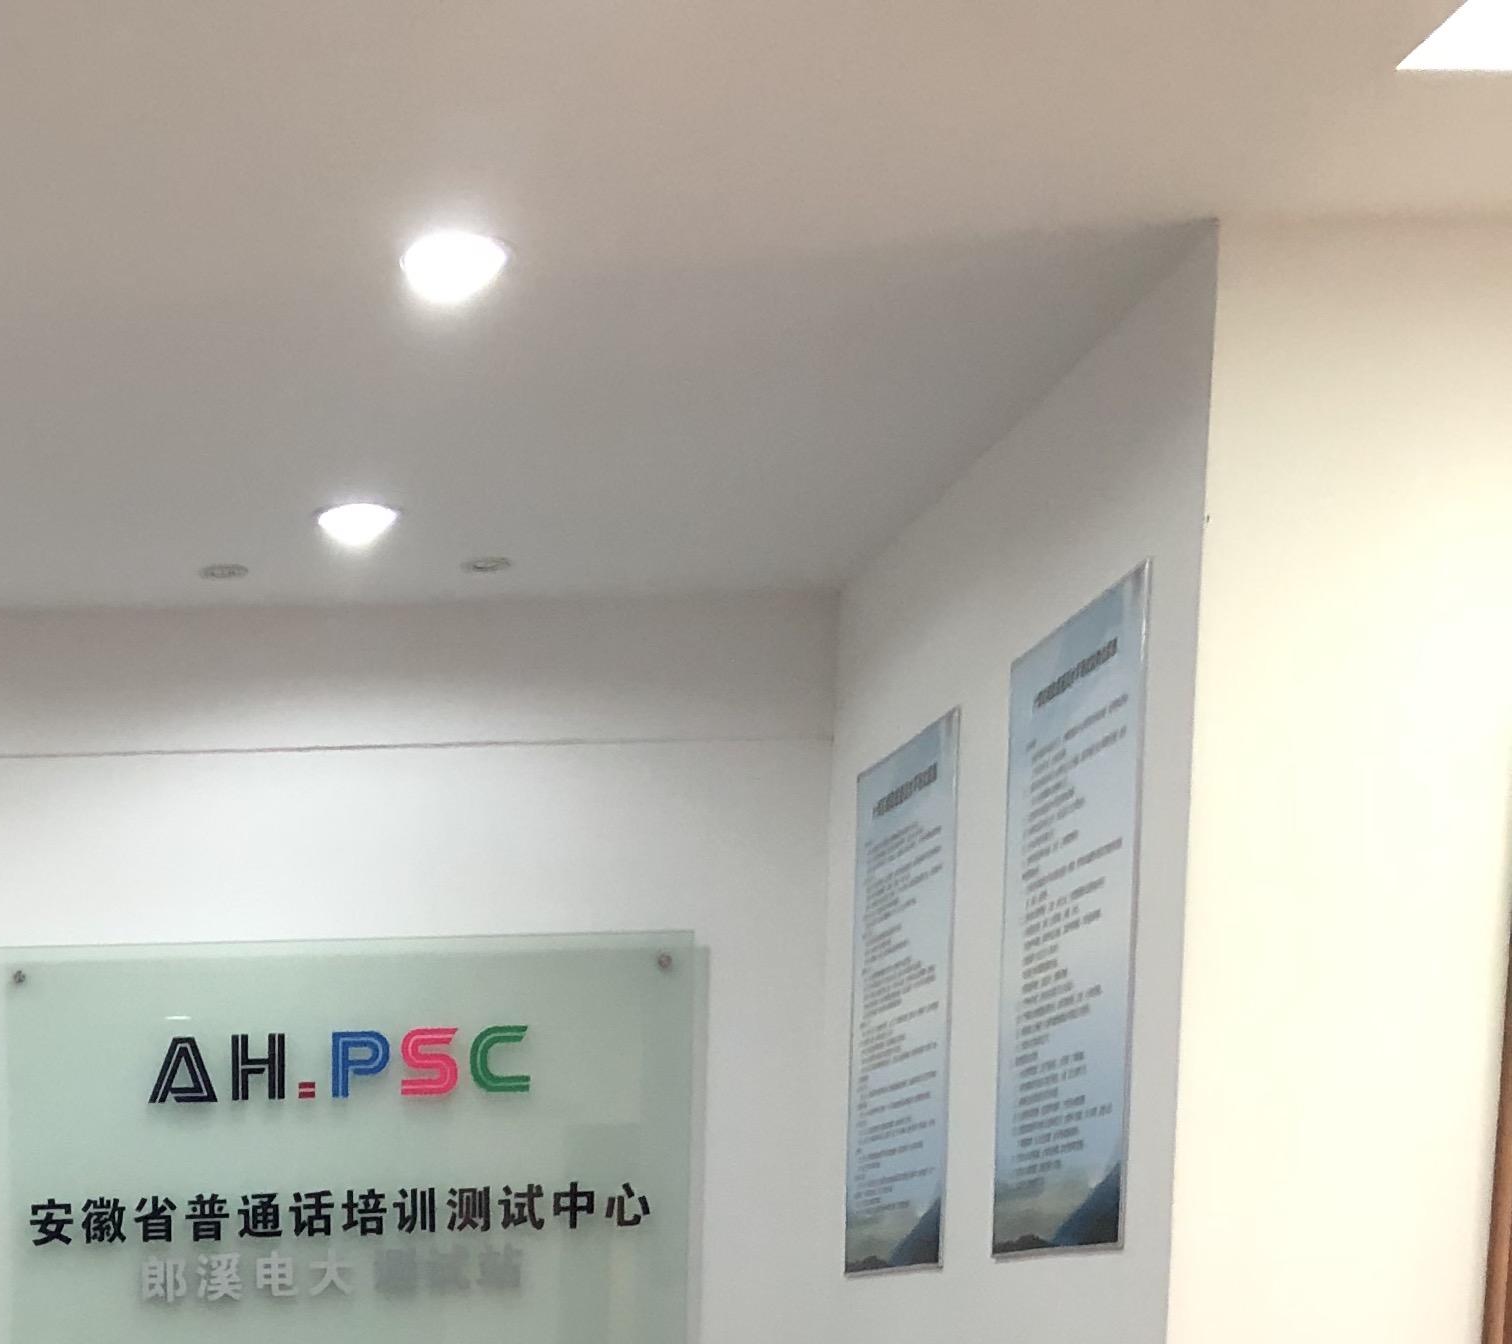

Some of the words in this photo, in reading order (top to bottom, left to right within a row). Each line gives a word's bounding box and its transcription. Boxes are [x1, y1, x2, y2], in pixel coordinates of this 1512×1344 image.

[148, 1025, 531, 1104] AH.PSC
[29, 1182, 651, 1246] 安徽省普通话培训测试中心
